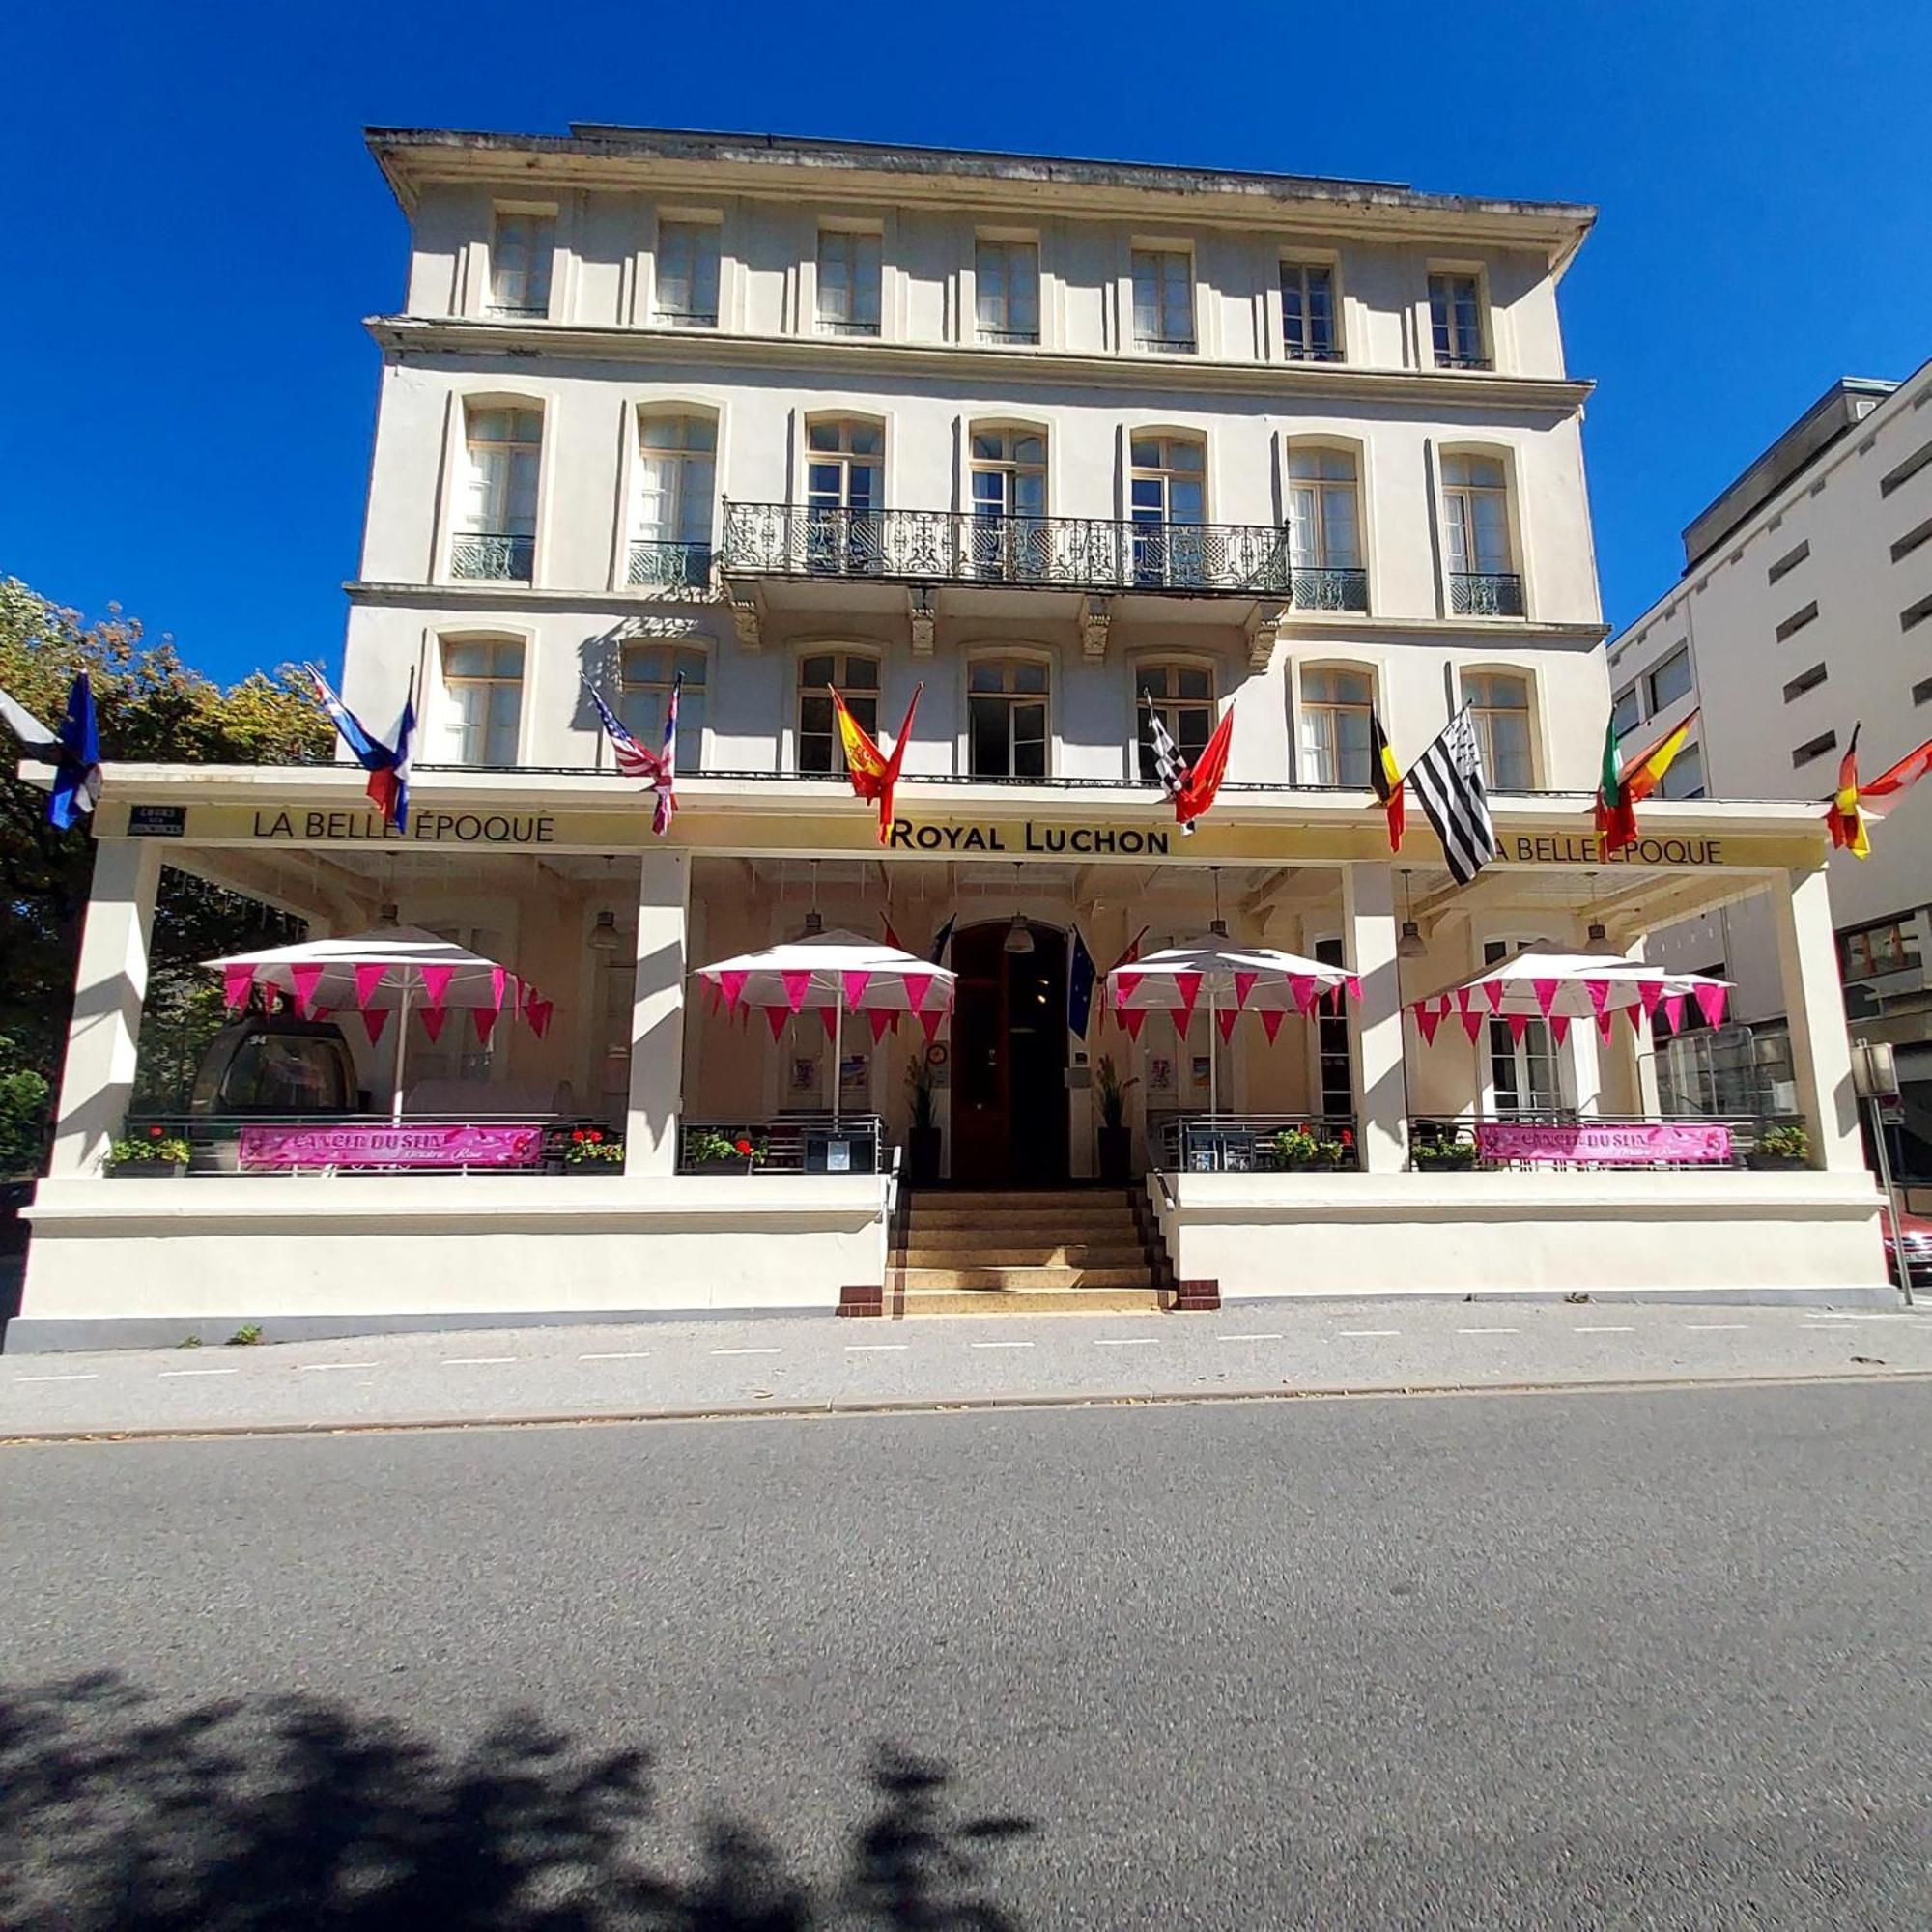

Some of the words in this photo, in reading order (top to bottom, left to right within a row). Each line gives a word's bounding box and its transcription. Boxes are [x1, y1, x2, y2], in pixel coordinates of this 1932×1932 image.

[253, 811, 294, 837] LA
[304, 812, 400, 838] BELLE
[414, 810, 554, 842] ÉPOQUE
[890, 819, 1005, 850] ROYAL
[1025, 821, 1169, 854] LUCHON
[1494, 837, 1509, 861] A
[1517, 838, 1598, 863] BELLE
